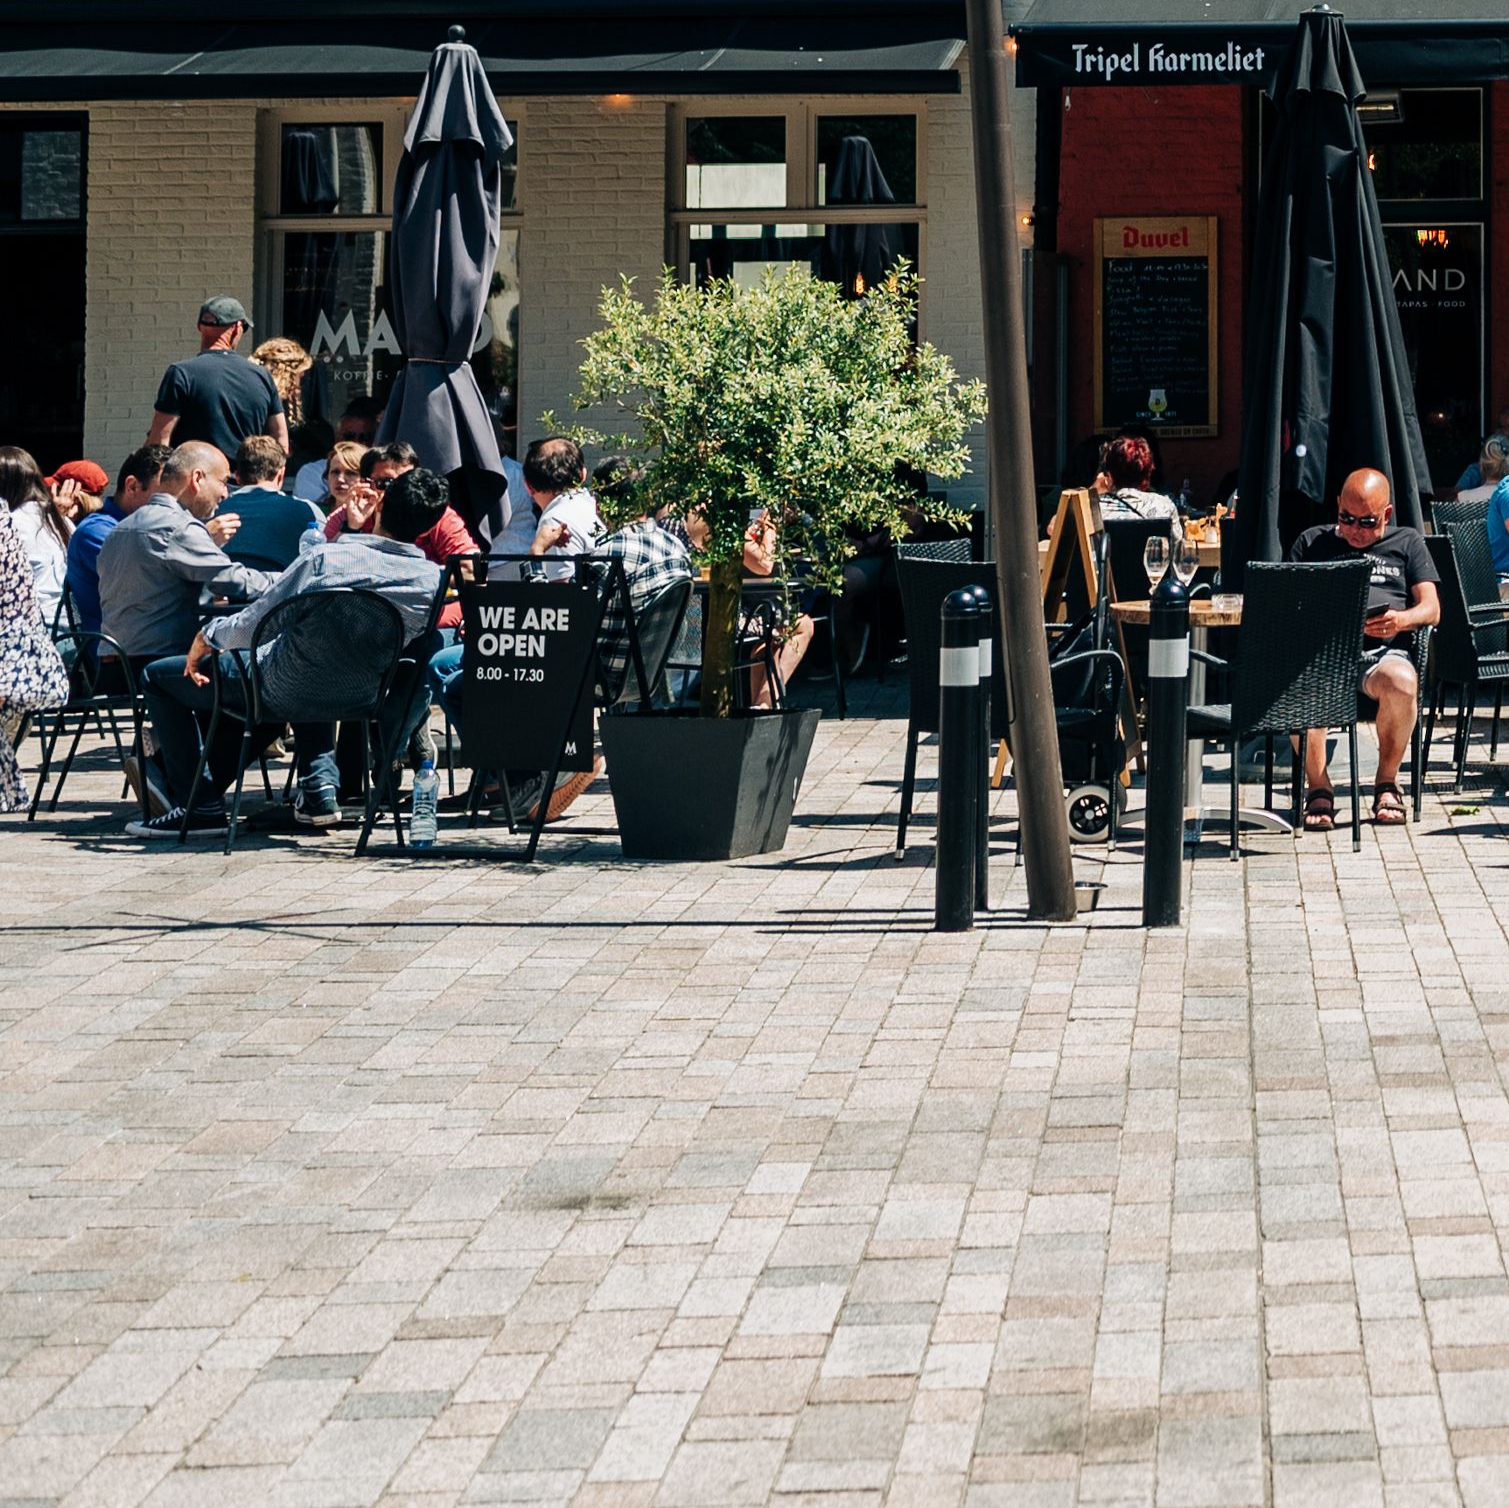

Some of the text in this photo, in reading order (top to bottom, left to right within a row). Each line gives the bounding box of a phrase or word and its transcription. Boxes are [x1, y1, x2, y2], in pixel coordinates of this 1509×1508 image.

[1071, 40, 1265, 81] Tripel Karmeliet
[1122, 225, 1190, 248] Duvel
[1438, 300, 1467, 308] FOOD
[333, 371, 390, 382] KOFFE-
[479, 606, 570, 631] WE ARE
[477, 632, 546, 657] OPEN
[476, 666, 502, 680] 8.00
[513, 668, 545, 682] 17.30
